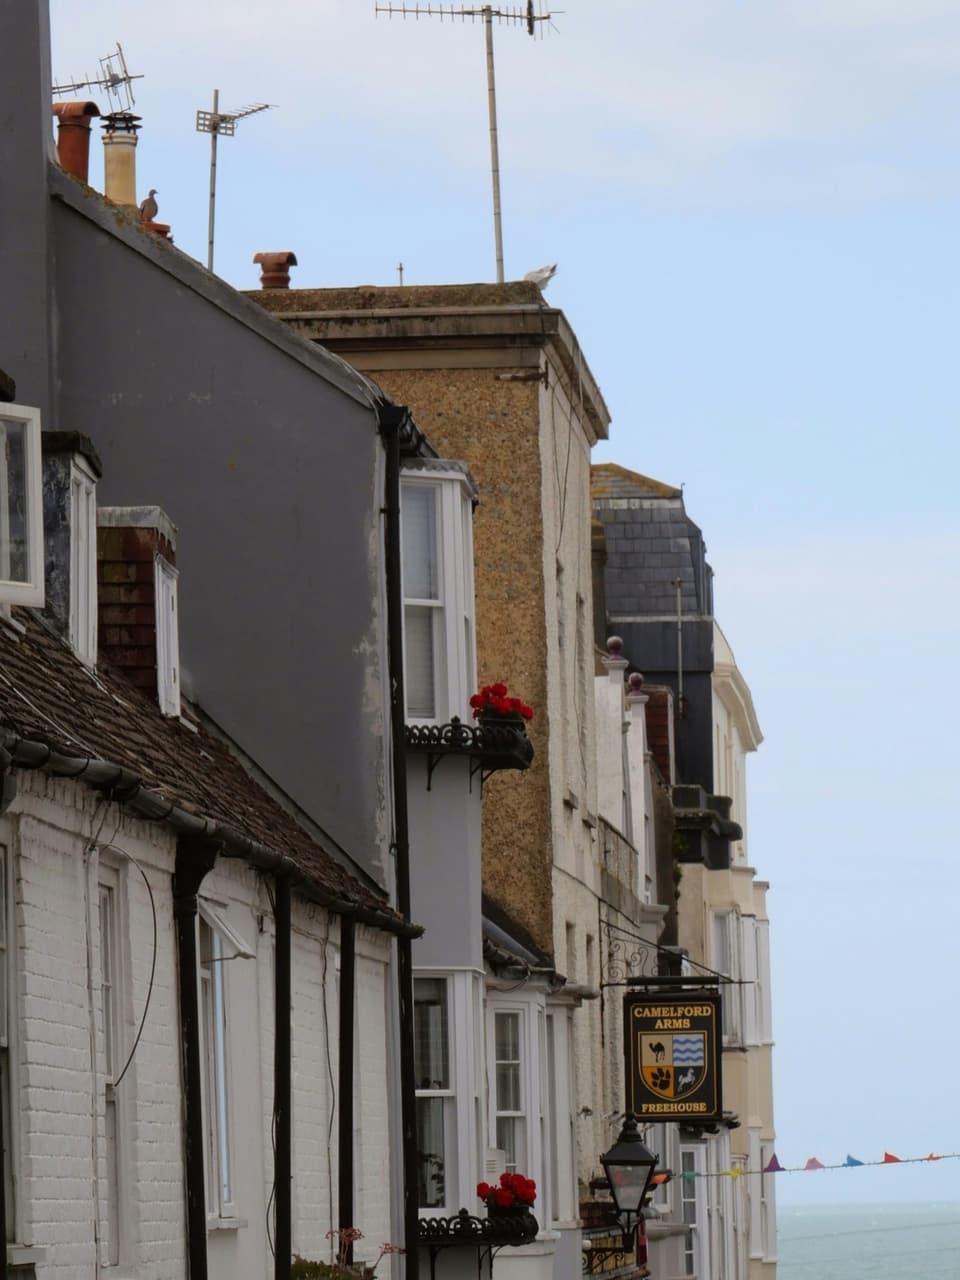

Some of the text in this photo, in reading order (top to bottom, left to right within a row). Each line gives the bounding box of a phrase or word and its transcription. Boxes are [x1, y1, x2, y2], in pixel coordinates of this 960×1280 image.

[634, 1006, 711, 1017] CAMELFORD
[655, 1018, 690, 1029] ARMS
[641, 1103, 707, 1113] FREEHOUSE
